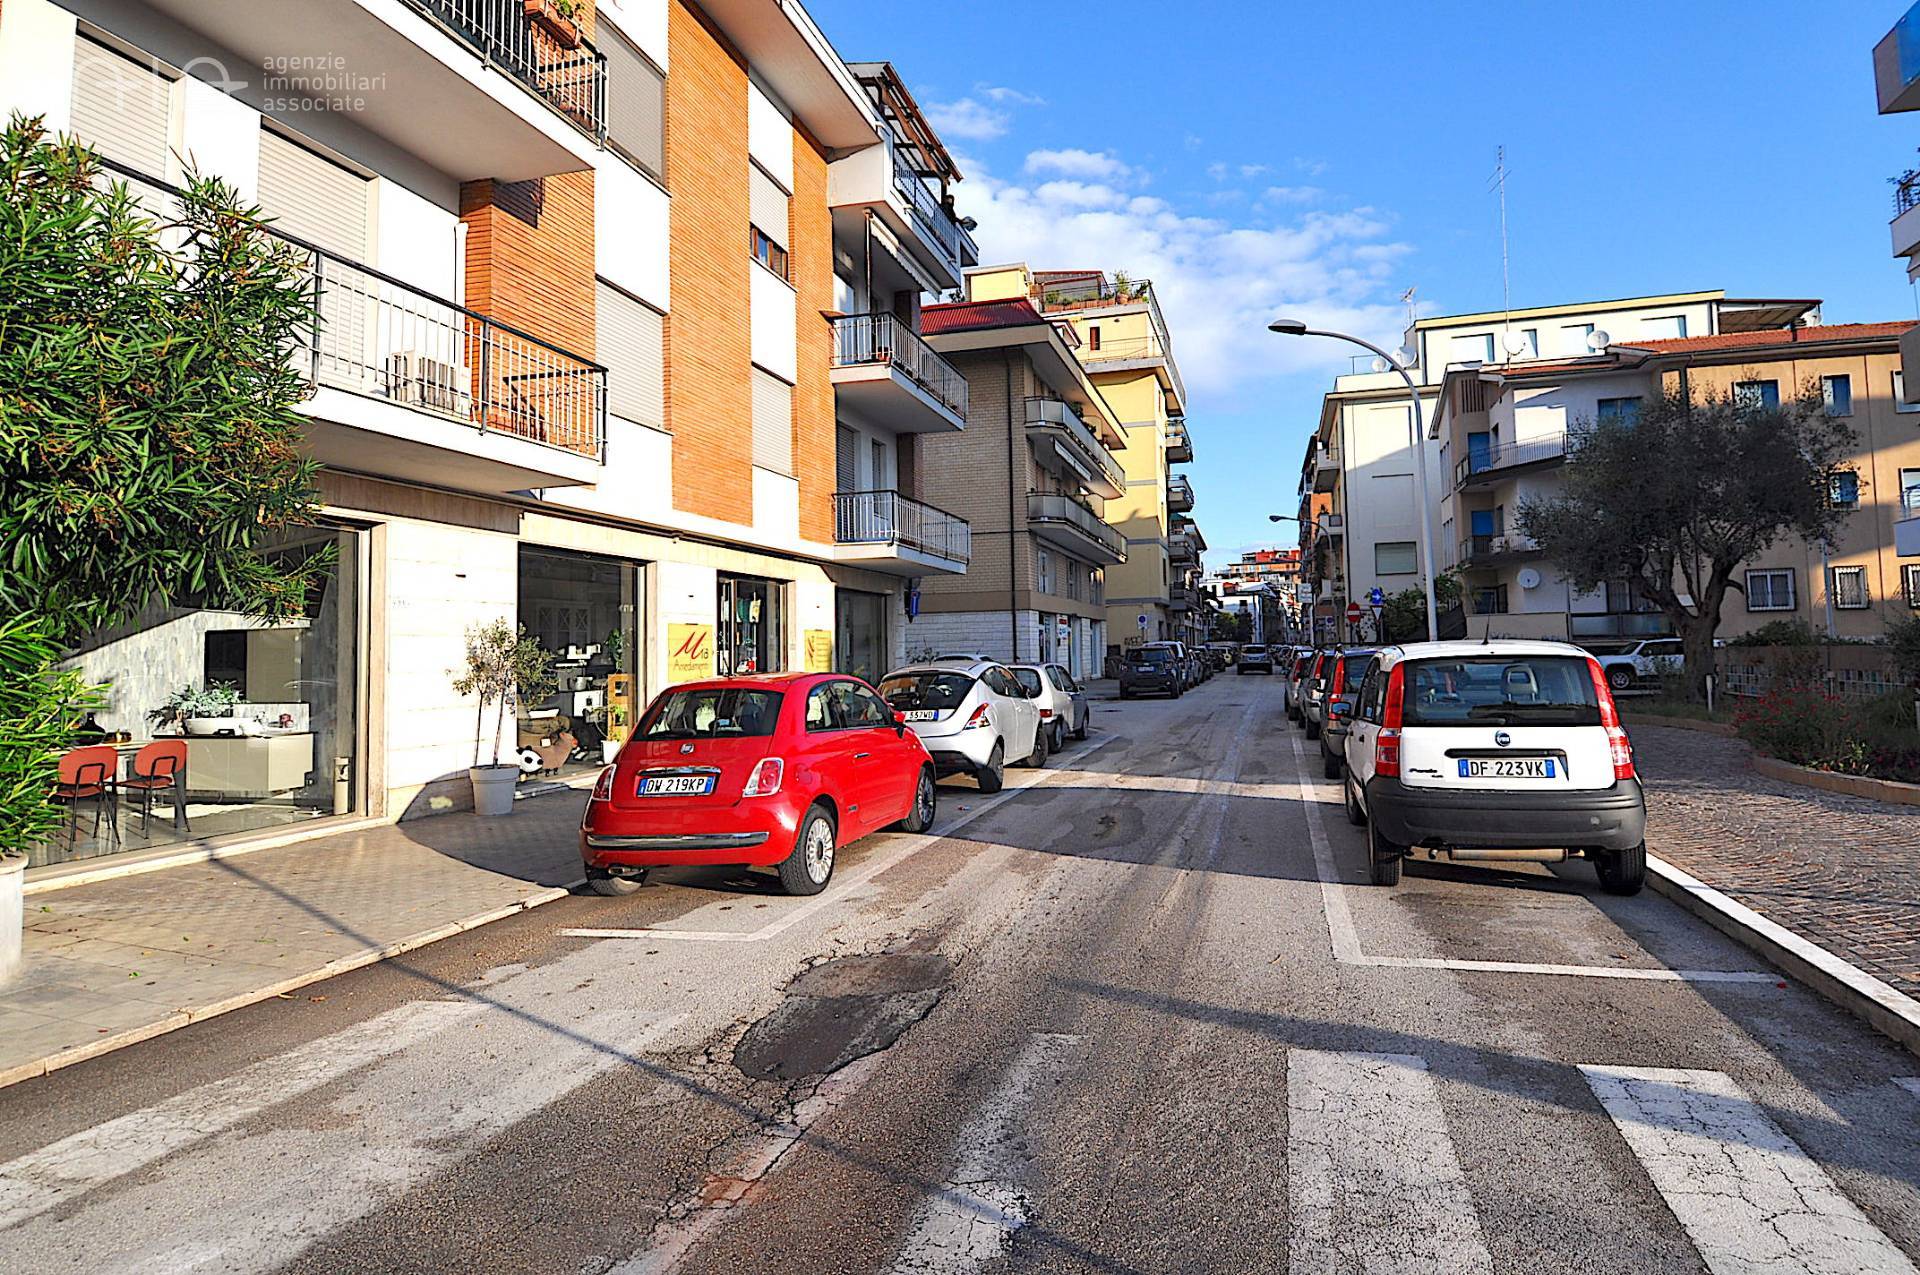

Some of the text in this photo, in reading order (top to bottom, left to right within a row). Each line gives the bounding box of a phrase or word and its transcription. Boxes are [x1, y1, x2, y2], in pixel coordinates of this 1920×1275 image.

[1470, 760, 1544, 776] DF 223VK
[646, 778, 705, 793] DW 219KP
